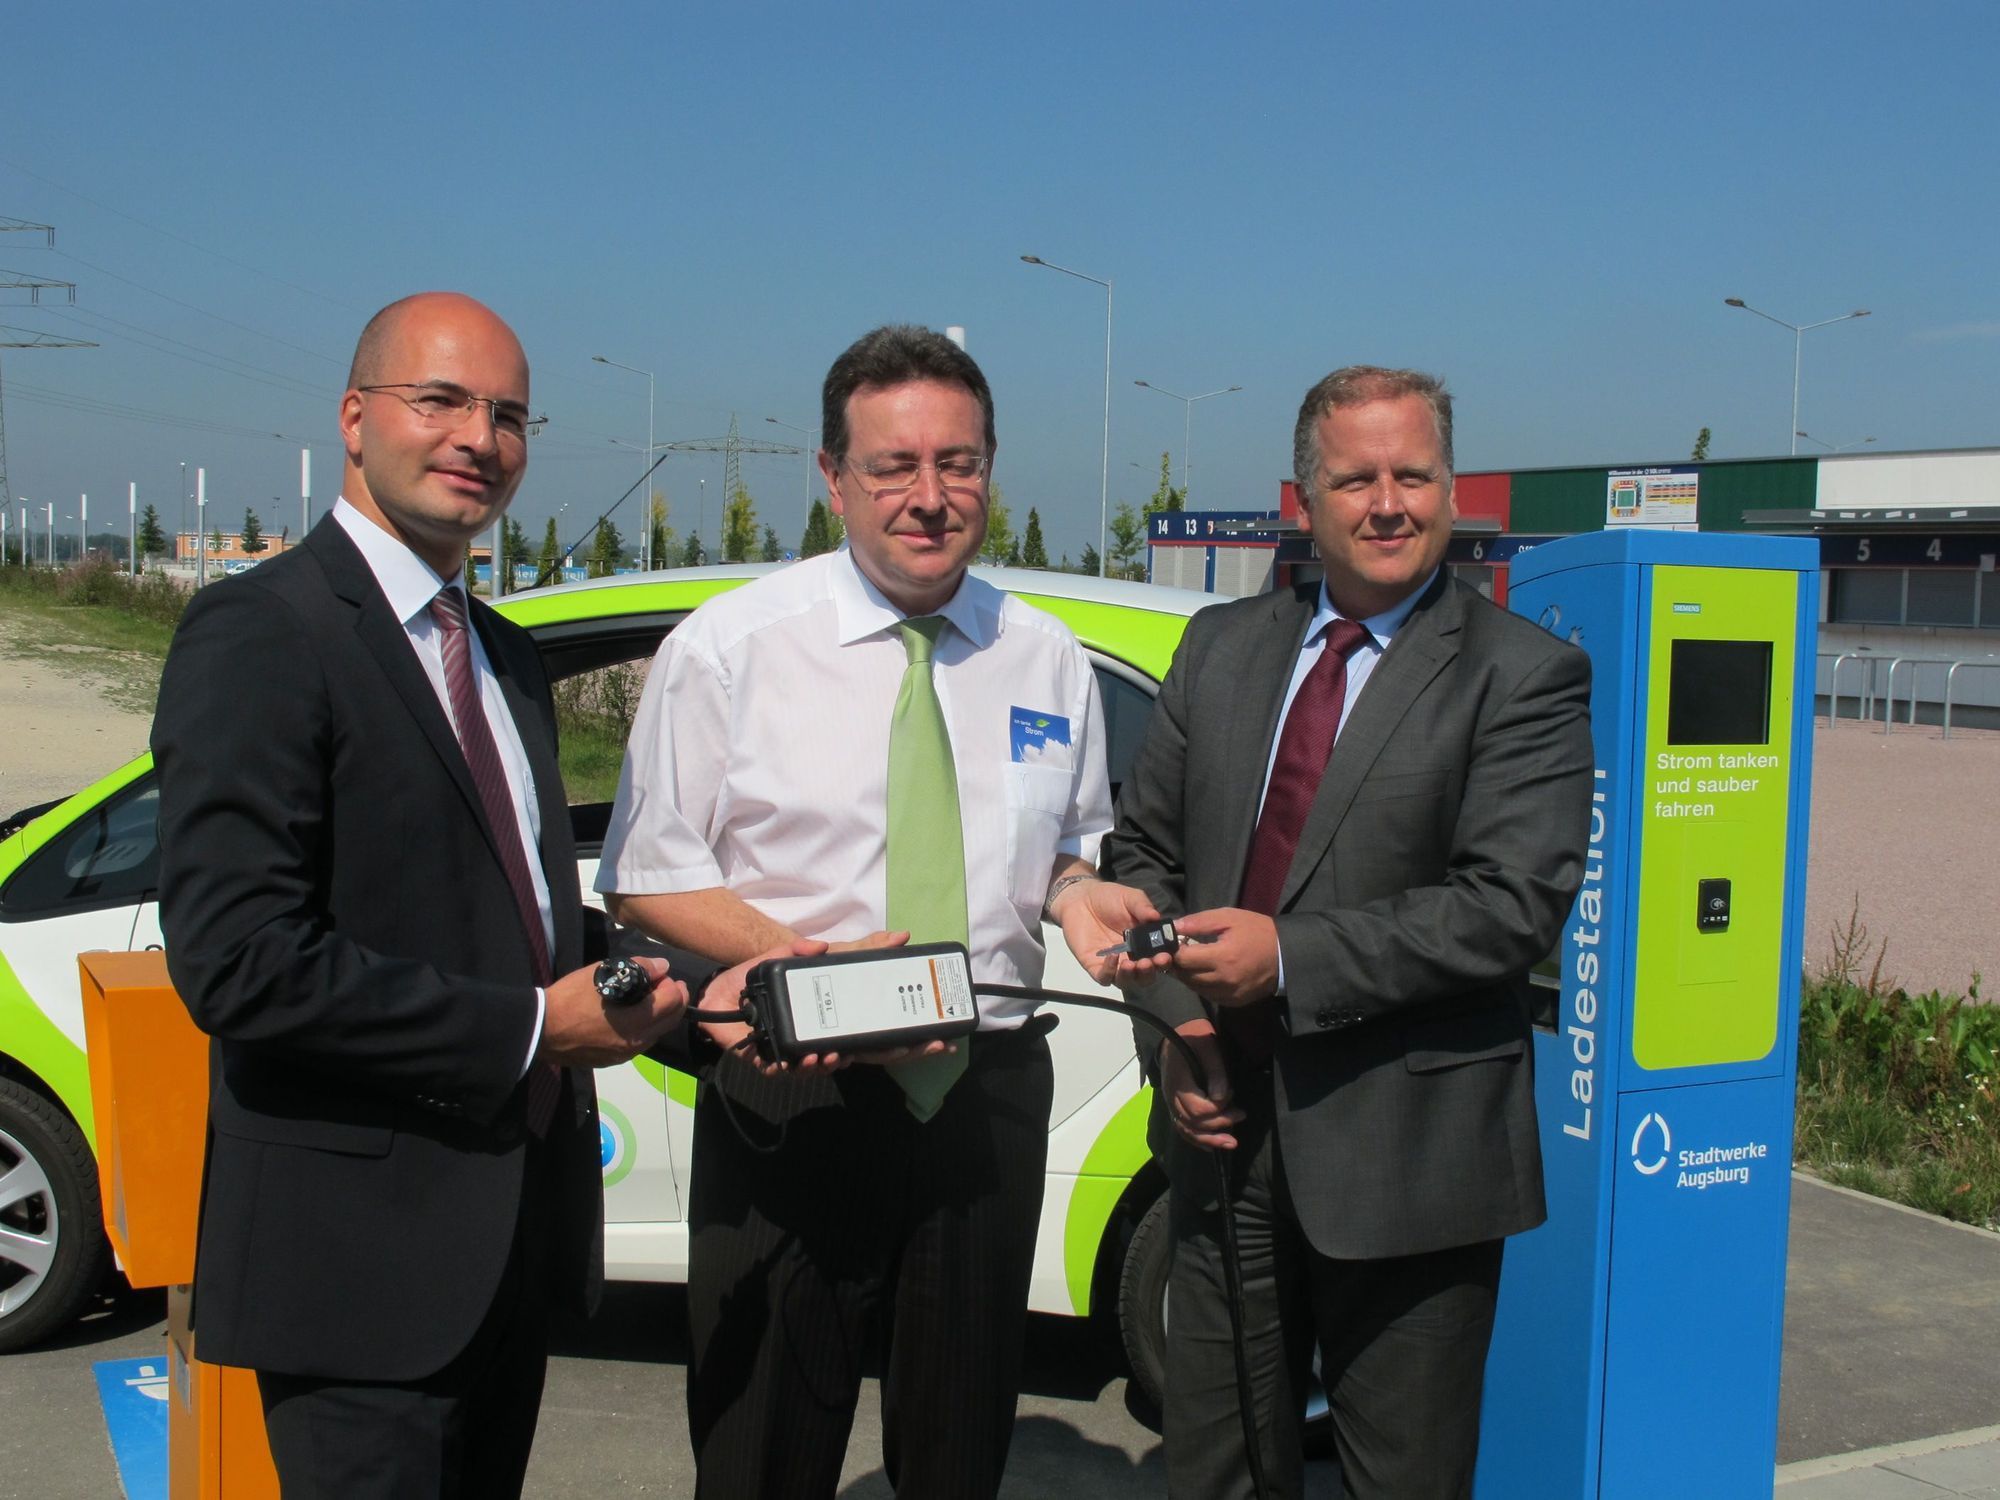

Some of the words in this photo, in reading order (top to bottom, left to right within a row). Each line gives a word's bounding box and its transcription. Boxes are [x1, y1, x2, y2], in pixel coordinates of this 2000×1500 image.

[1158, 519, 1168, 535] 14
[1185, 519, 1197, 535] 13
[1473, 540, 1484, 560] 6
[1857, 538, 1870, 562] 5
[1926, 538, 1942, 562] 4
[1673, 604, 1700, 613] SIEMENS
[1025, 726, 1044, 737] Strom
[1657, 753, 1712, 769] Strom
[1718, 752, 1779, 769] tanken
[1656, 777, 1690, 793] und
[1696, 776, 1759, 793] sauber
[1655, 801, 1714, 818] fahren
[824, 999, 833, 1011] 16
[1678, 1141, 1767, 1168] Stadtwerke
[1676, 1166, 1749, 1190] Augsburg
